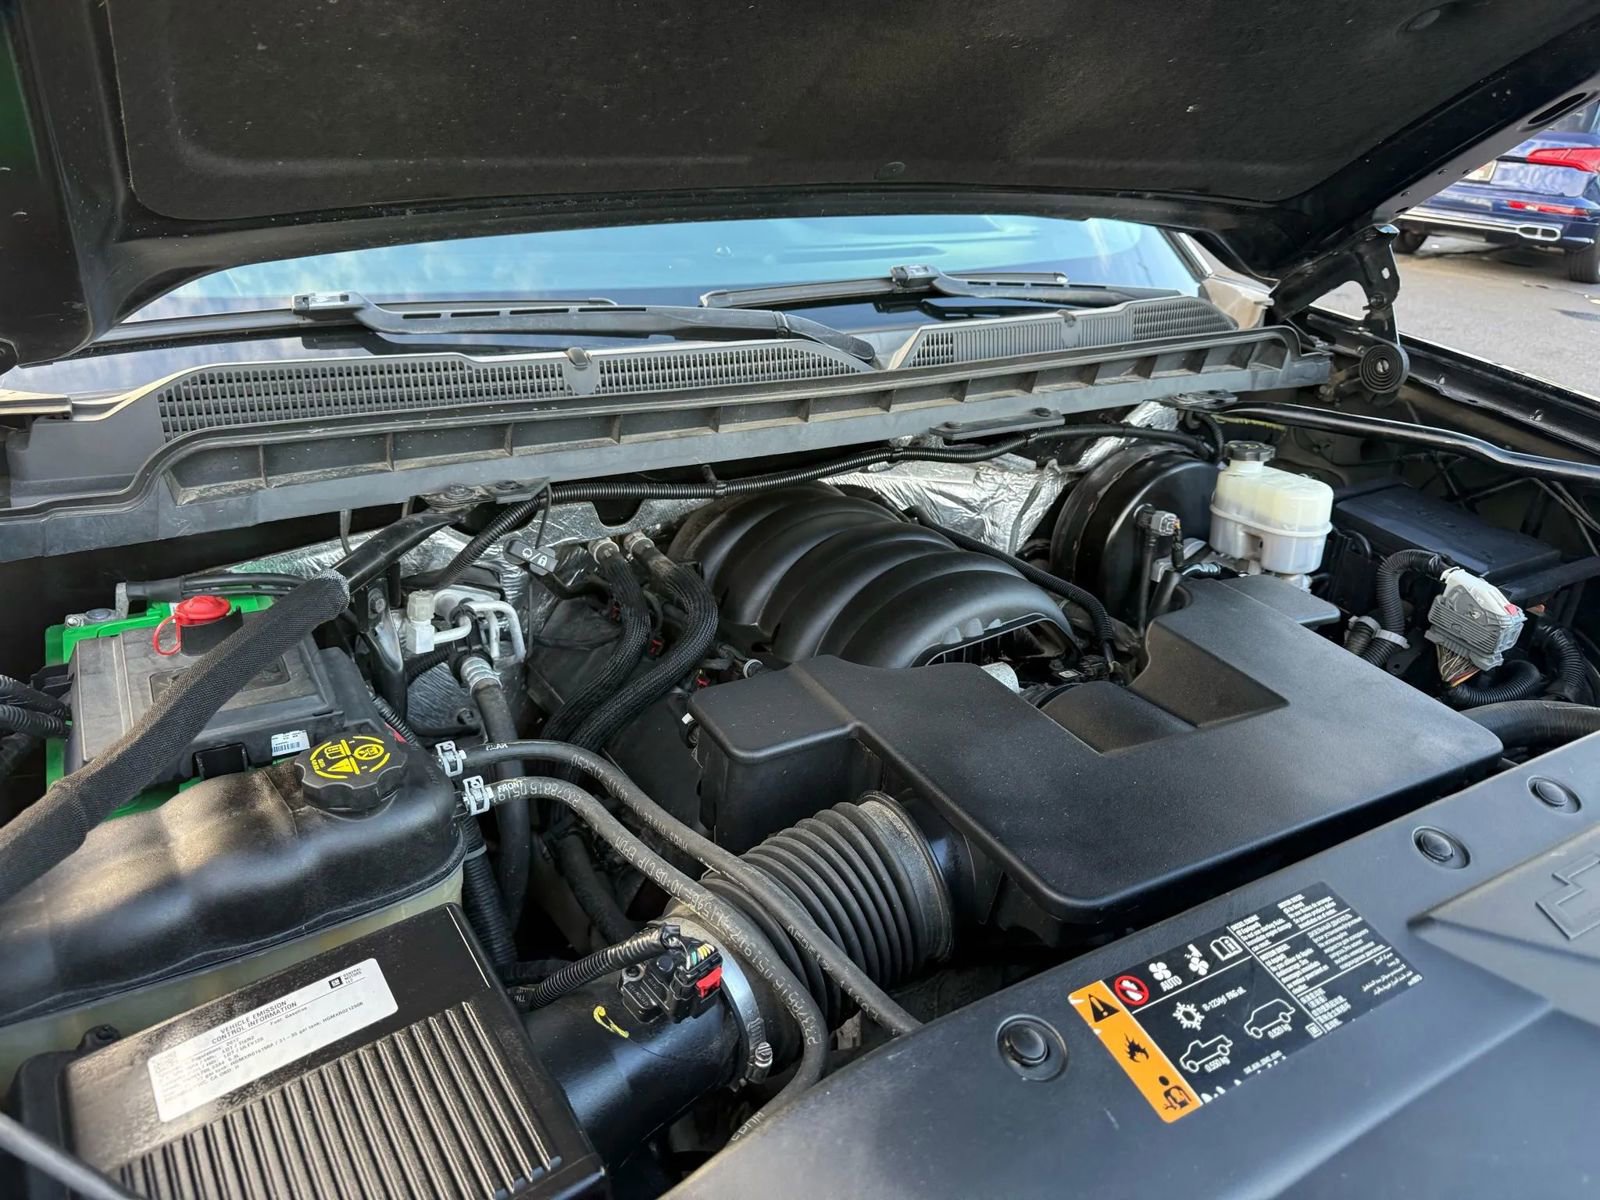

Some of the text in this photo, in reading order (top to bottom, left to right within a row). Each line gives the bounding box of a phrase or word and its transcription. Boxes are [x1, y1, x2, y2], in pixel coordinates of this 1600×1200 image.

[1157, 974, 1184, 992] AUTO
[211, 1000, 297, 1044] CONTROL INFORMATION
[220, 999, 287, 1035] VEHICLE EMISSION
